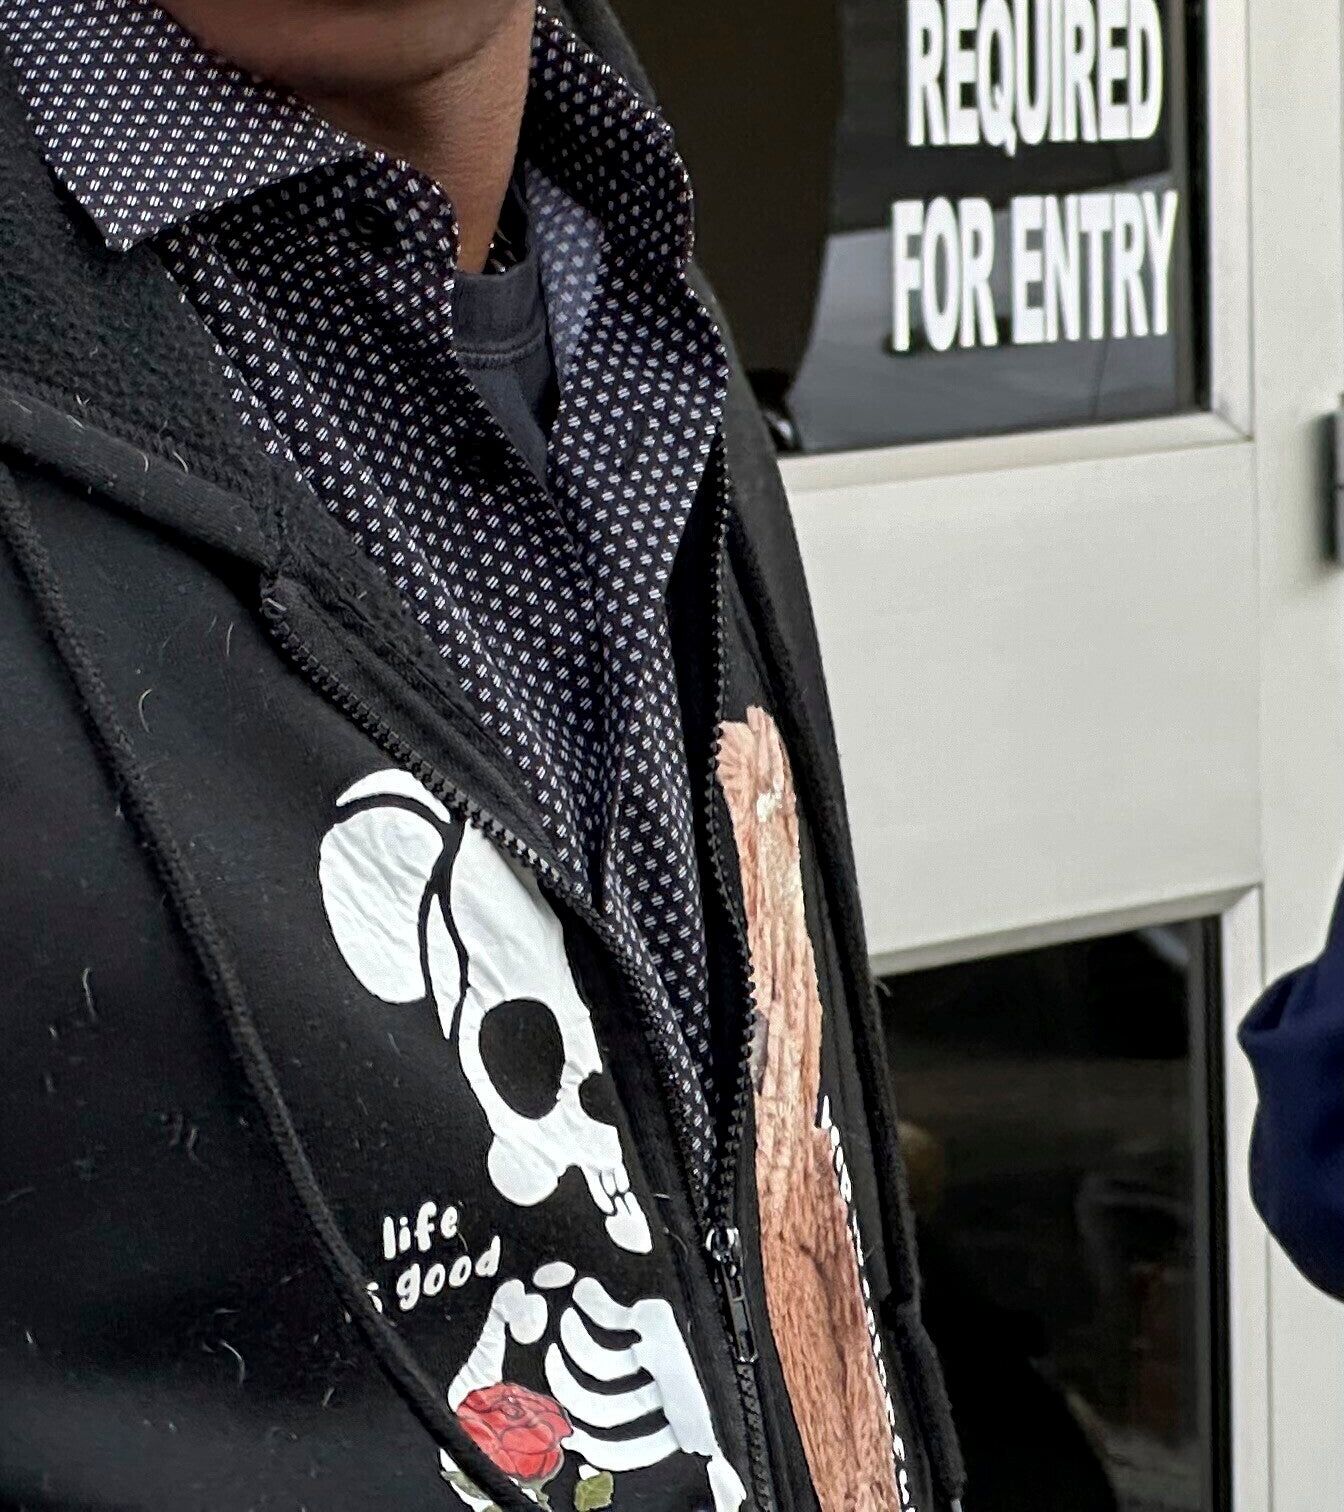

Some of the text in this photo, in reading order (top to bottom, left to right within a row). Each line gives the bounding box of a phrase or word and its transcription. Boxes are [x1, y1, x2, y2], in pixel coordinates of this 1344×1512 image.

[892, 190, 1178, 352] FOR ENTRY
[383, 1201, 457, 1261] life
[396, 1235, 500, 1311] good
